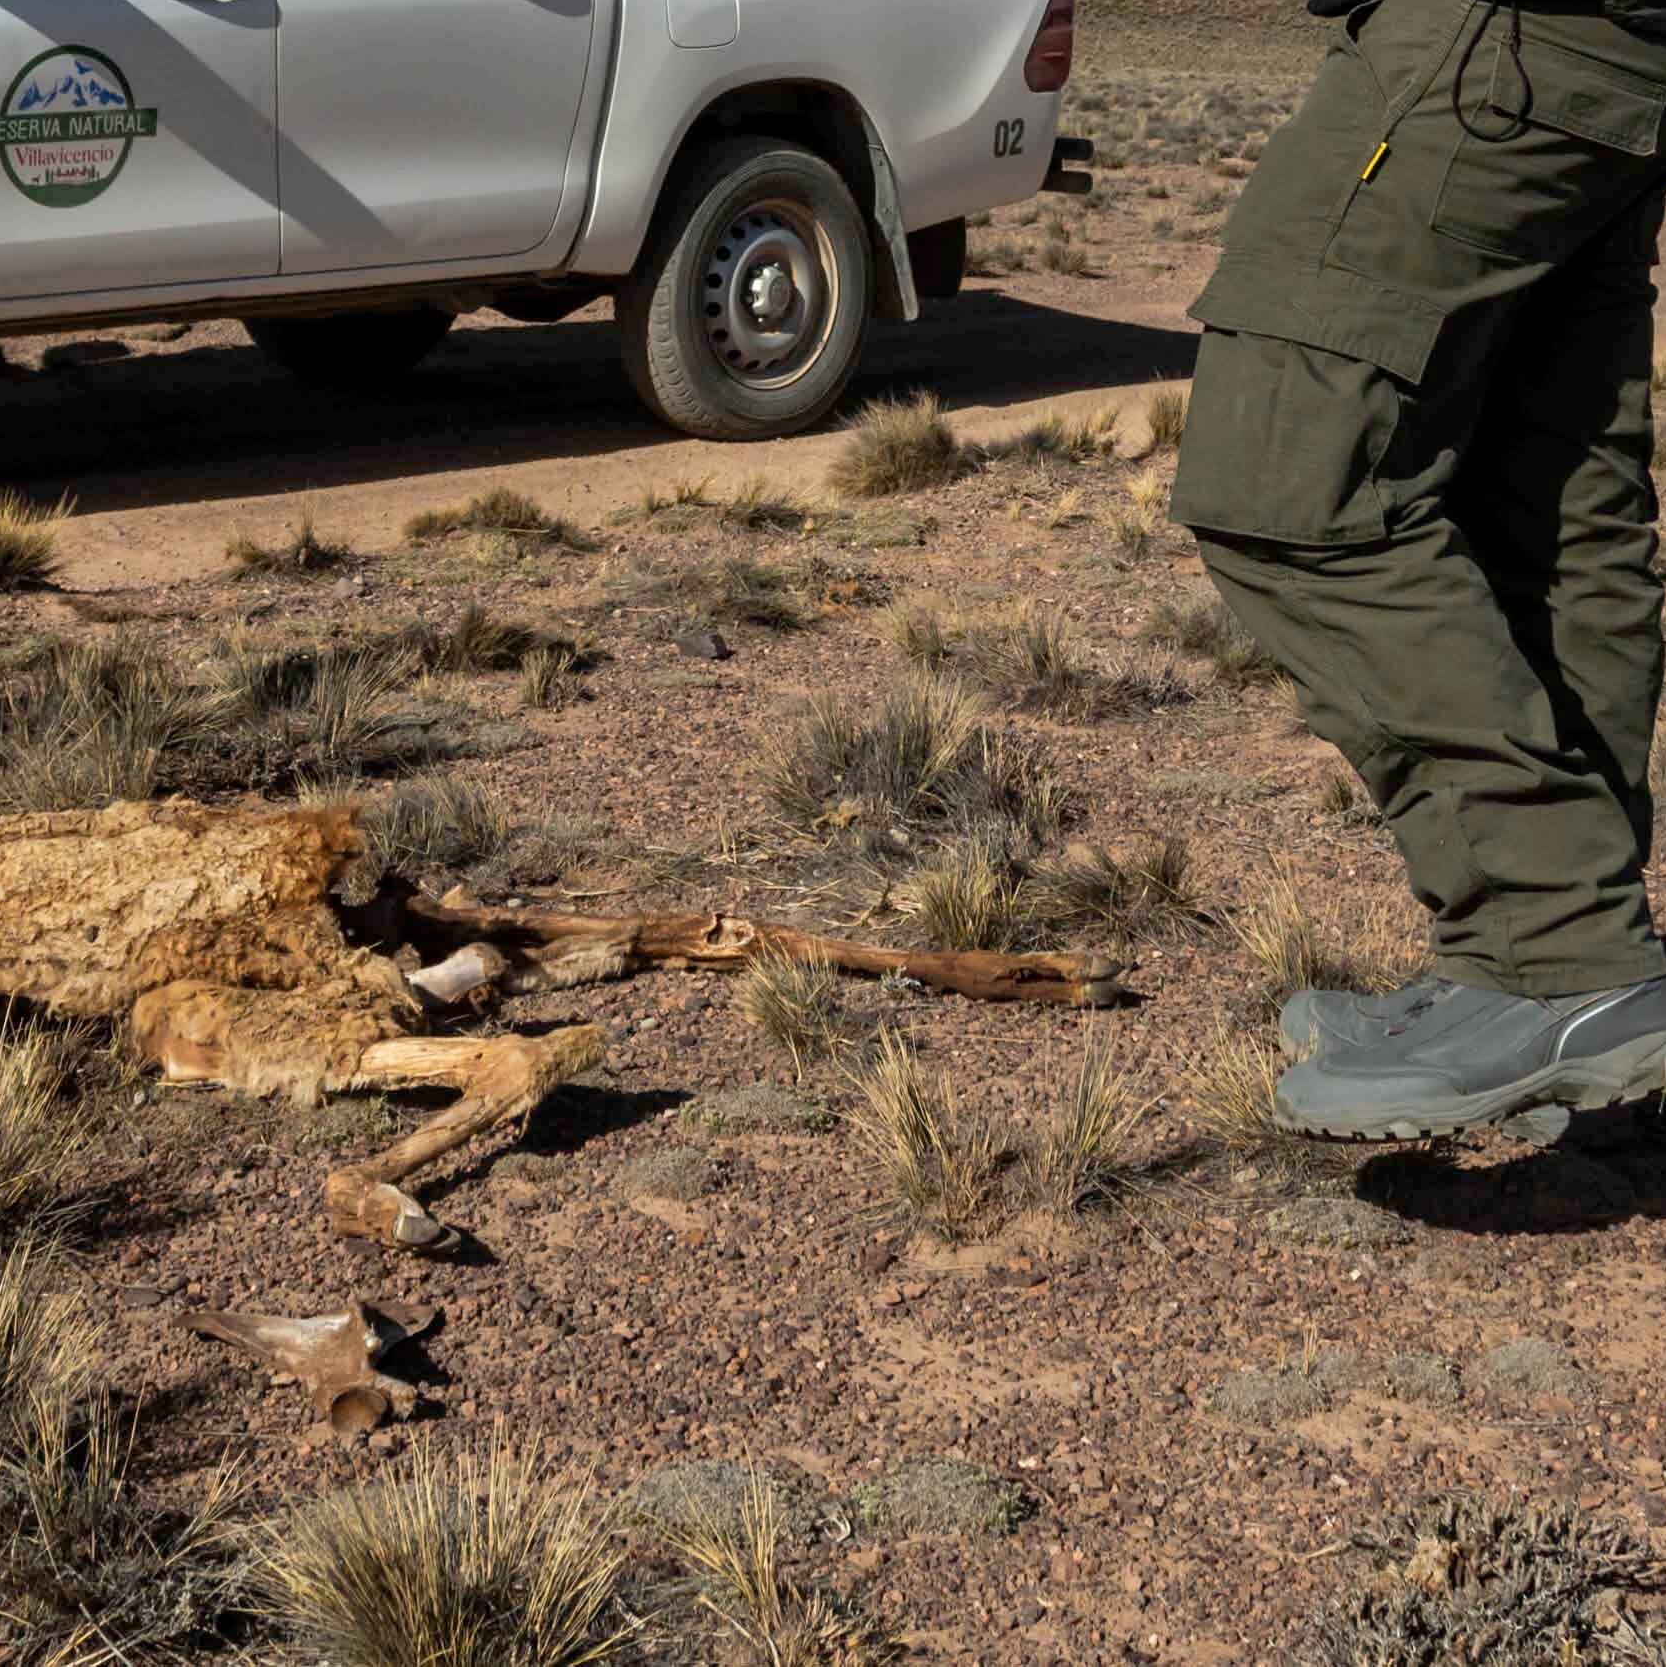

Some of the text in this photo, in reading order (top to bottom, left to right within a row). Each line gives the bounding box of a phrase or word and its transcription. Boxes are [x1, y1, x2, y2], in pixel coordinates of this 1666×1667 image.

[69, 114, 146, 135] NATURAL
[995, 119, 1024, 158] 02
[14, 144, 113, 166] Villavicencio
